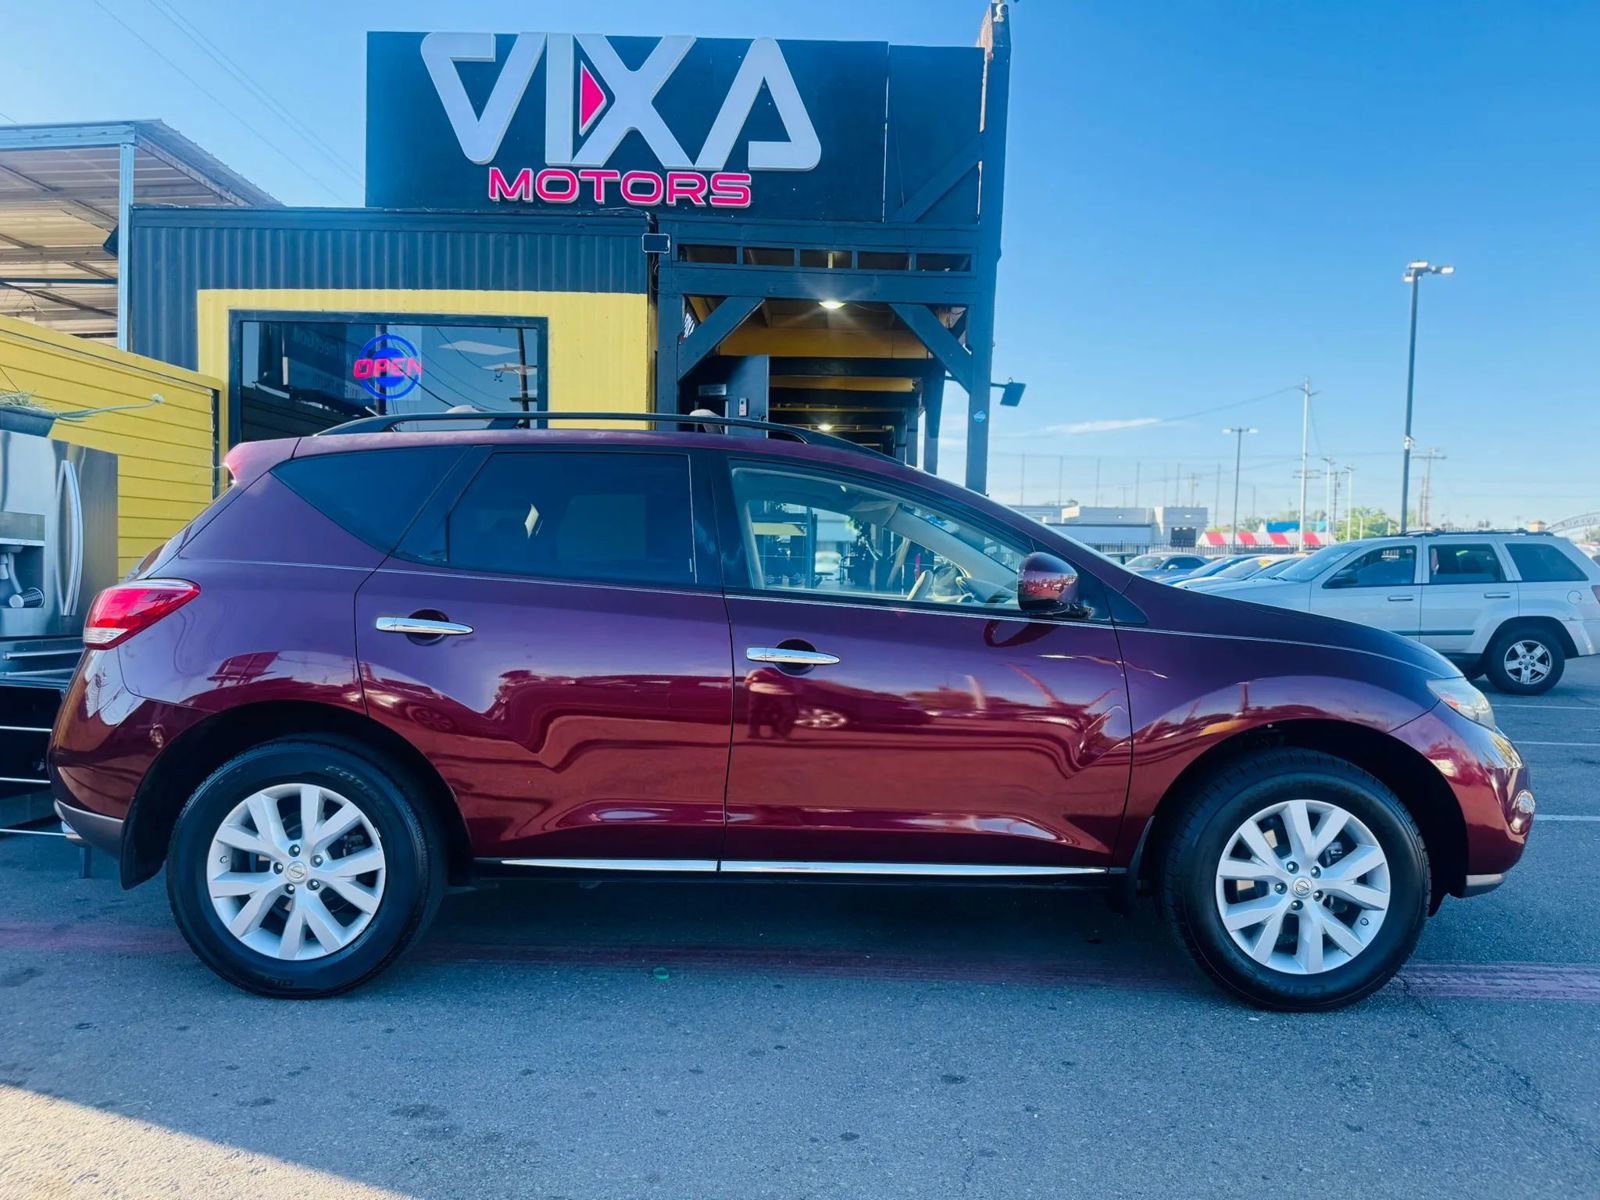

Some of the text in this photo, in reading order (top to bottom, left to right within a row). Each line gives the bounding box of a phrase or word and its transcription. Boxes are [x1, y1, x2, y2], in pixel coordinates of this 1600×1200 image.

[420, 32, 822, 171] VIXA
[488, 167, 752, 208] MOTORS
[353, 357, 423, 379] OPEN
